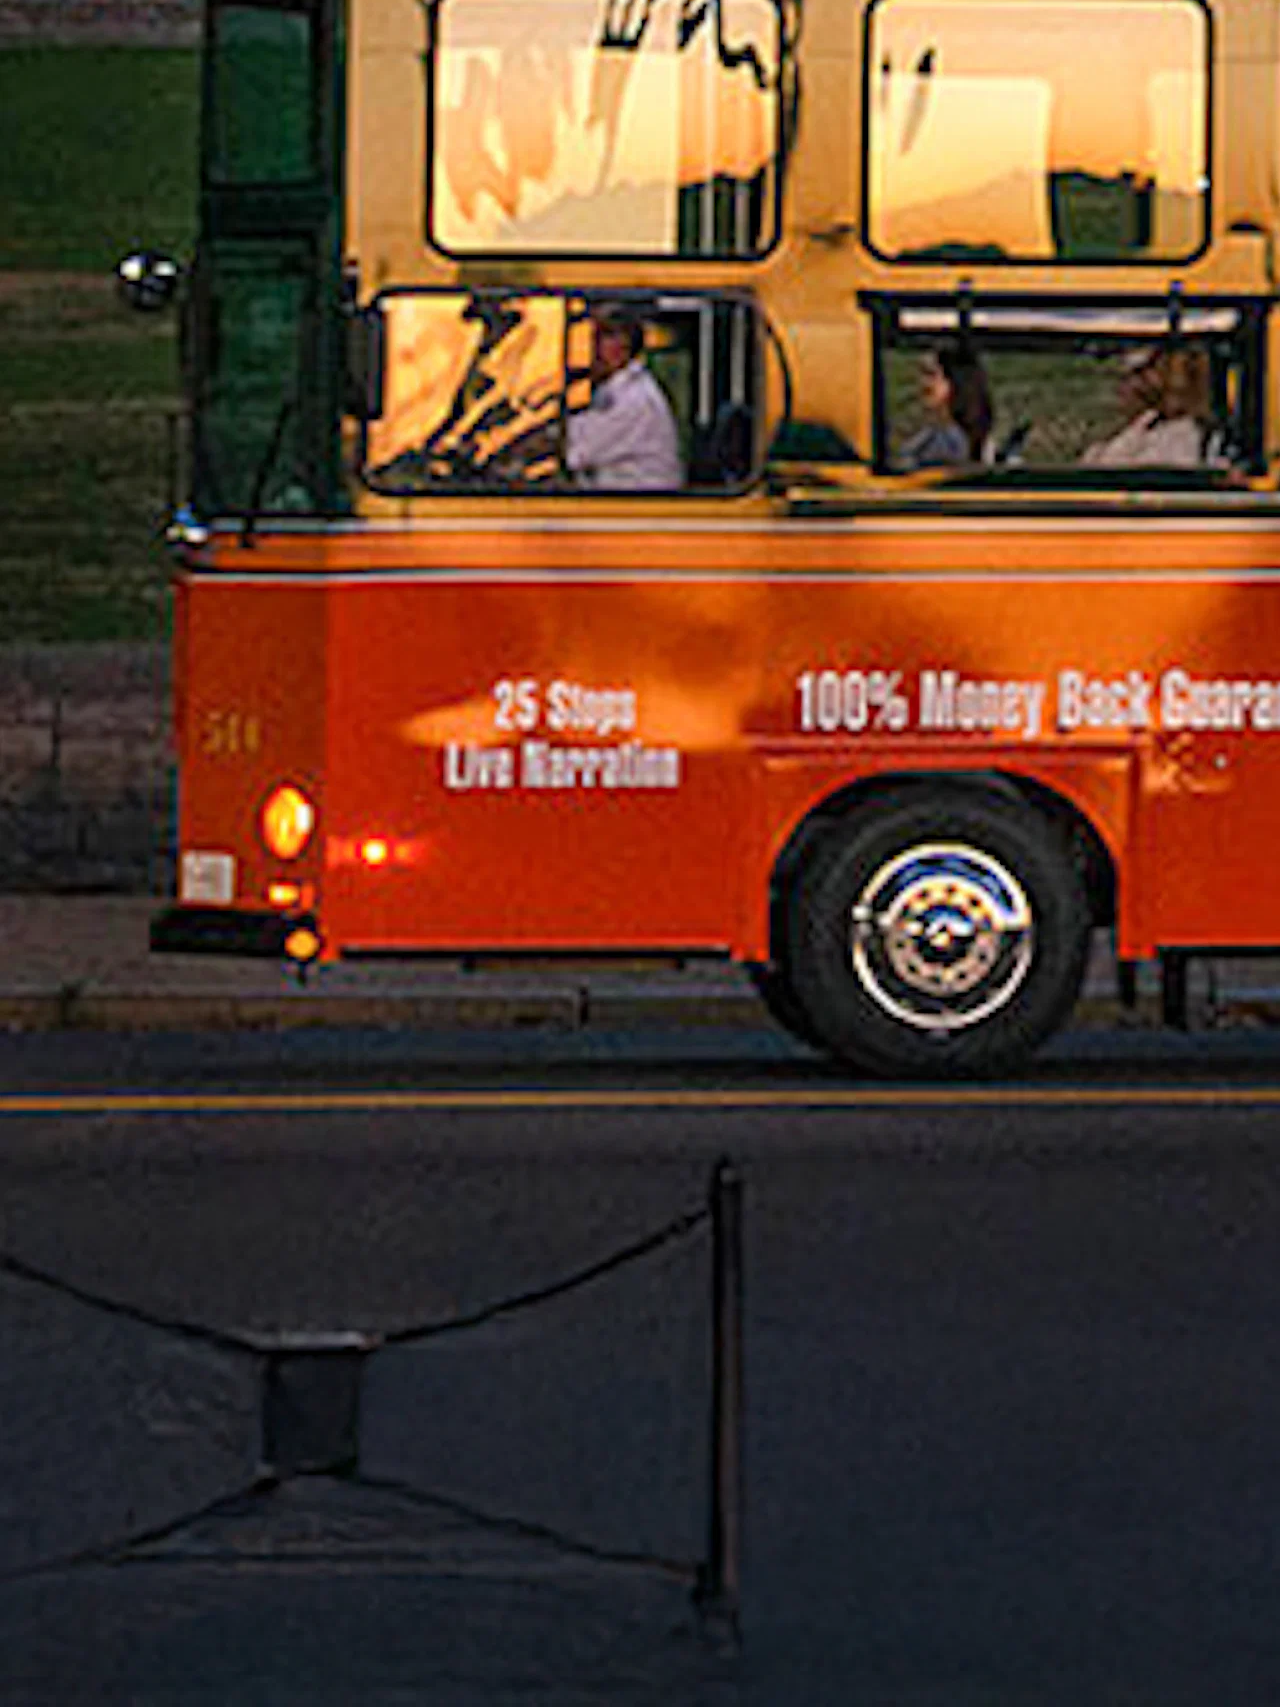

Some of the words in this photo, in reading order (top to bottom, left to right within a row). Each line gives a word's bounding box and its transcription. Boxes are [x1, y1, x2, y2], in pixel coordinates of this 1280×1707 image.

[493, 681, 540, 730] 25
[796, 670, 909, 733] 100%
[918, 670, 1044, 741] Money
[1055, 670, 1152, 729] Back
[443, 742, 514, 790] Live
[522, 742, 681, 790] Narration
